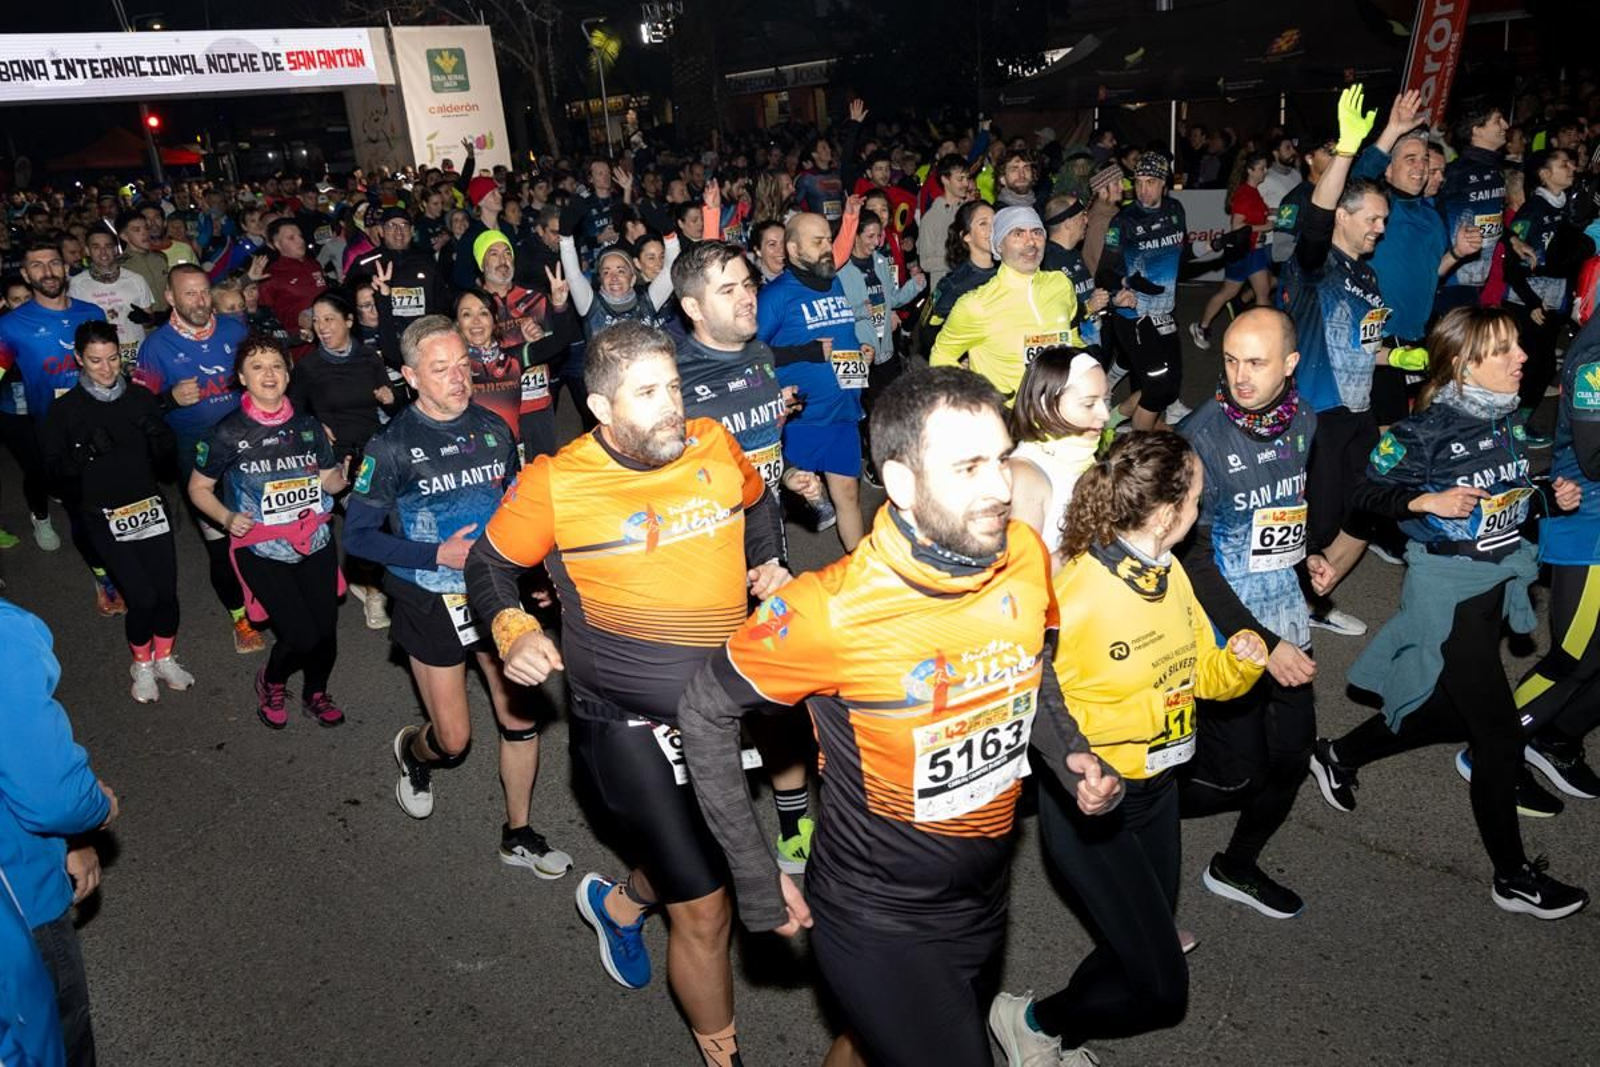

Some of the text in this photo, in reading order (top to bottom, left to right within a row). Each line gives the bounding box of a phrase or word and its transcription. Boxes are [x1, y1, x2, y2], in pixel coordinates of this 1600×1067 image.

[51, 54, 204, 80] INTERNACIONAL
[205, 52, 260, 74] NOCHE
[262, 51, 284, 72] DE
[285, 51, 317, 70] SAN
[317, 48, 366, 68] ANTON
[428, 102, 479, 114] calderón
[1468, 190, 1490, 202] SAN
[1138, 239, 1159, 251] SAN
[801, 296, 840, 326] LIFE
[833, 361, 866, 374] 7230
[721, 392, 786, 434] AN ANTÓ
[240, 459, 271, 474] SAN
[418, 472, 457, 496] SAN
[263, 486, 319, 509] 10005
[1233, 484, 1272, 512] SAN
[115, 507, 159, 532] 6029
[1272, 510, 1288, 522] 42
[1259, 523, 1305, 548] 629
[1166, 692, 1181, 707] 42
[945, 720, 968, 739] 42
[928, 719, 1024, 783] 5163
